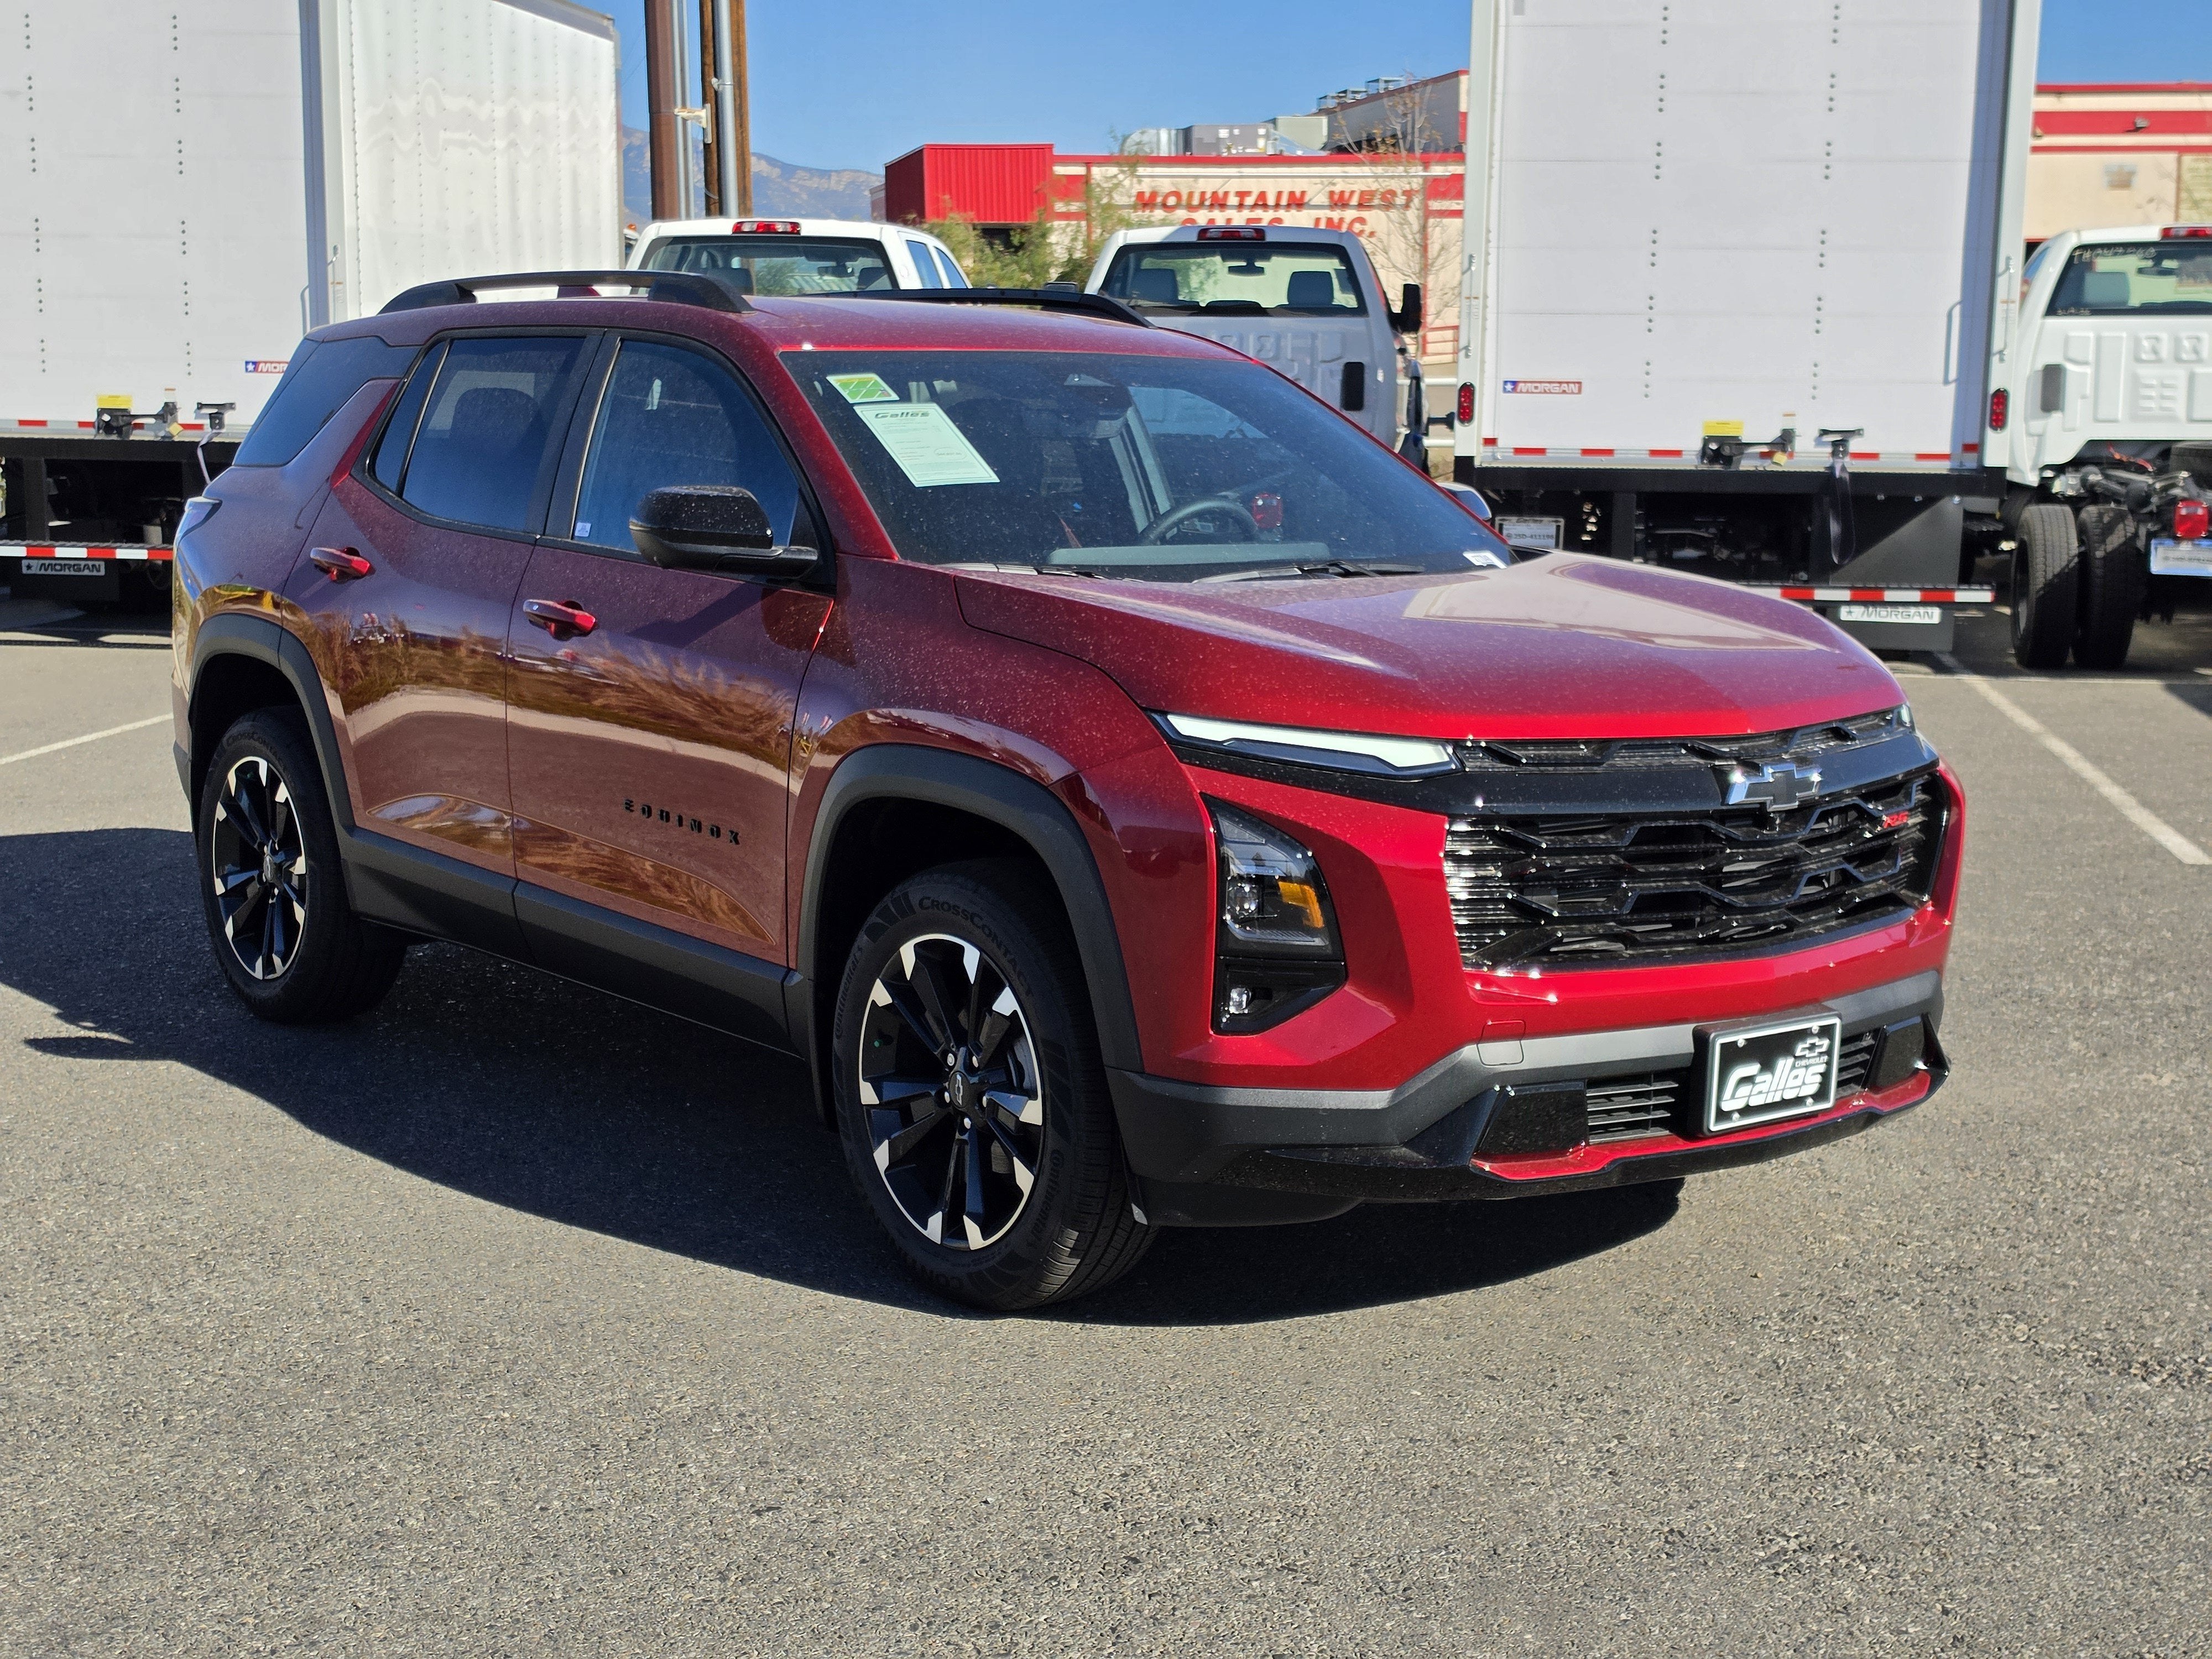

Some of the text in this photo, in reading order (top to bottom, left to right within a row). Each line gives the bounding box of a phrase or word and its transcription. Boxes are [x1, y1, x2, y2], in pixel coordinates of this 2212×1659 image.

[1134, 189, 1420, 213] MOUNTAIN WEST
[1516, 383, 1579, 393] MORGAN
[39, 562, 101, 573] MORGAN
[1860, 608, 1934, 620] MORGAN
[623, 799, 740, 845] EQUINOX
[1882, 811, 1909, 829] RS
[1720, 1057, 1827, 1112] Galles
